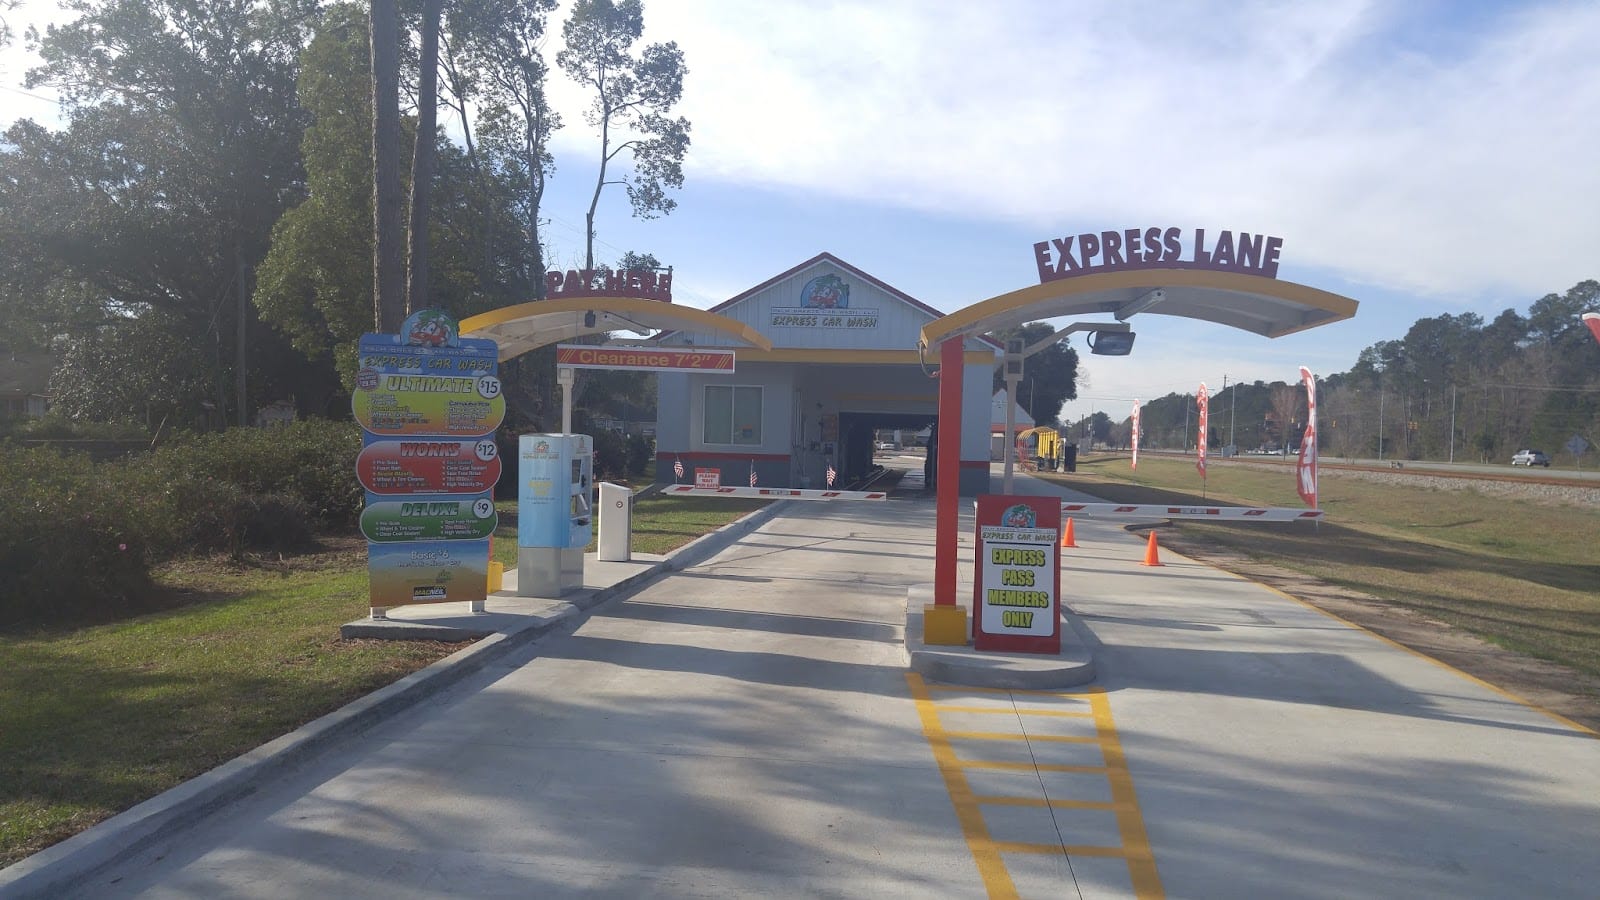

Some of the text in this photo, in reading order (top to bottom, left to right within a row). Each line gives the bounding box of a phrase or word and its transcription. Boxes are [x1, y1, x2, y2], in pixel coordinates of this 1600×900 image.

[1033, 227, 1284, 277] EXPRESS LANE
[547, 269, 672, 299] PAY HERE
[772, 315, 877, 328] EXPRESS CAR WASH
[364, 355, 494, 371] EXPRESS CAR WASH
[579, 350, 712, 368] Clearance 7'2"
[387, 375, 473, 393] ULTIMATE
[480, 380, 498, 394] $15
[400, 442, 461, 457] WORKS
[478, 444, 494, 456] $12
[401, 502, 460, 517] DELUXE
[478, 503, 489, 514] $9
[982, 532, 1056, 542] EXPRESS CAR WASH
[411, 550, 449, 560] Basic $6
[992, 548, 1046, 567] EXPRESS
[1002, 569, 1035, 586] PASS
[987, 588, 1049, 608] MEMBERS
[1002, 610, 1034, 628] ONLY
